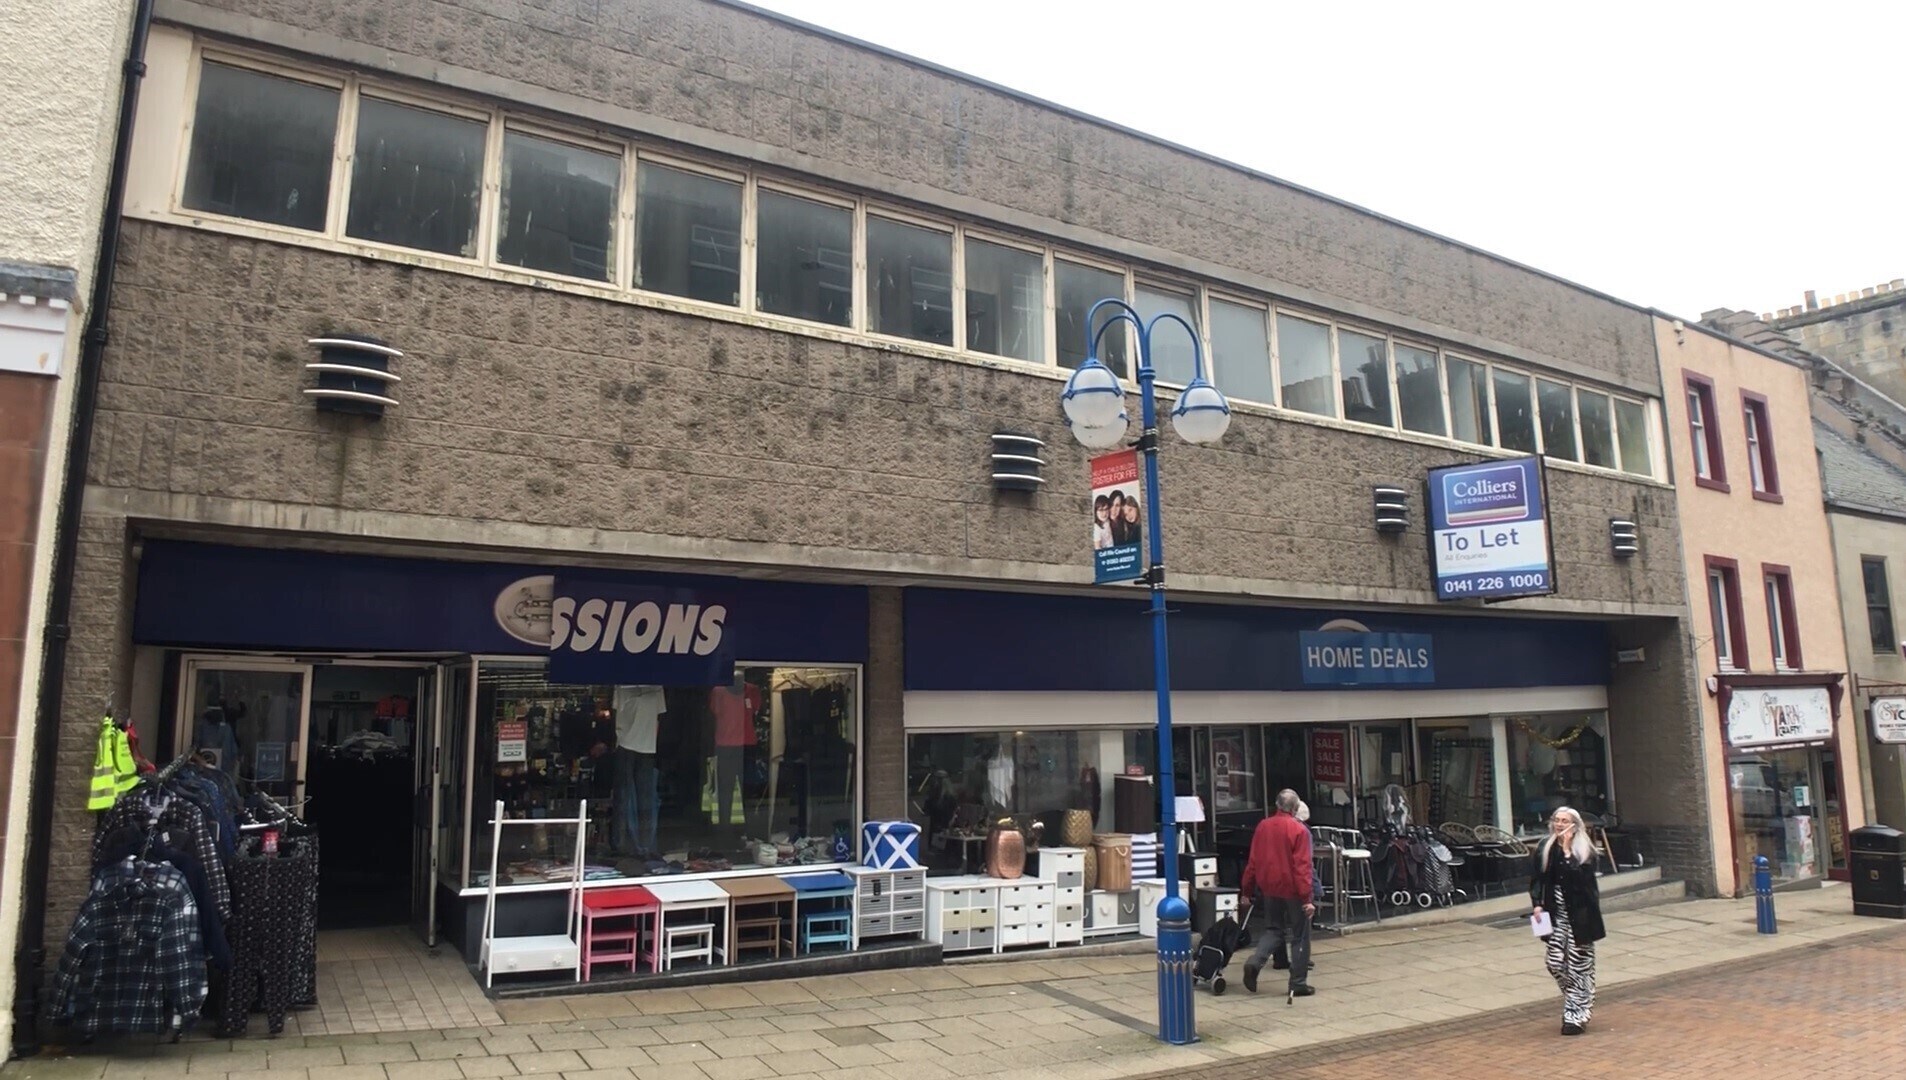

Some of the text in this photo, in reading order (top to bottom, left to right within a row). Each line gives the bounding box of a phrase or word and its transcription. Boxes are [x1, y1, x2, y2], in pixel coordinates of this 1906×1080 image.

[1113, 471, 1125, 481] FOR
[1125, 468, 1137, 479] FIFE
[1453, 479, 1517, 498] Colliers
[1454, 493, 1517, 505] INTERNATIONAL
[1443, 528, 1520, 551] To Let
[1444, 573, 1543, 593] 0141 226 1000
[1307, 646, 1429, 669] HOME DEALS
[1315, 738, 1340, 749] SALE
[1316, 751, 1341, 763] SALE
[1315, 765, 1342, 777] SALE
